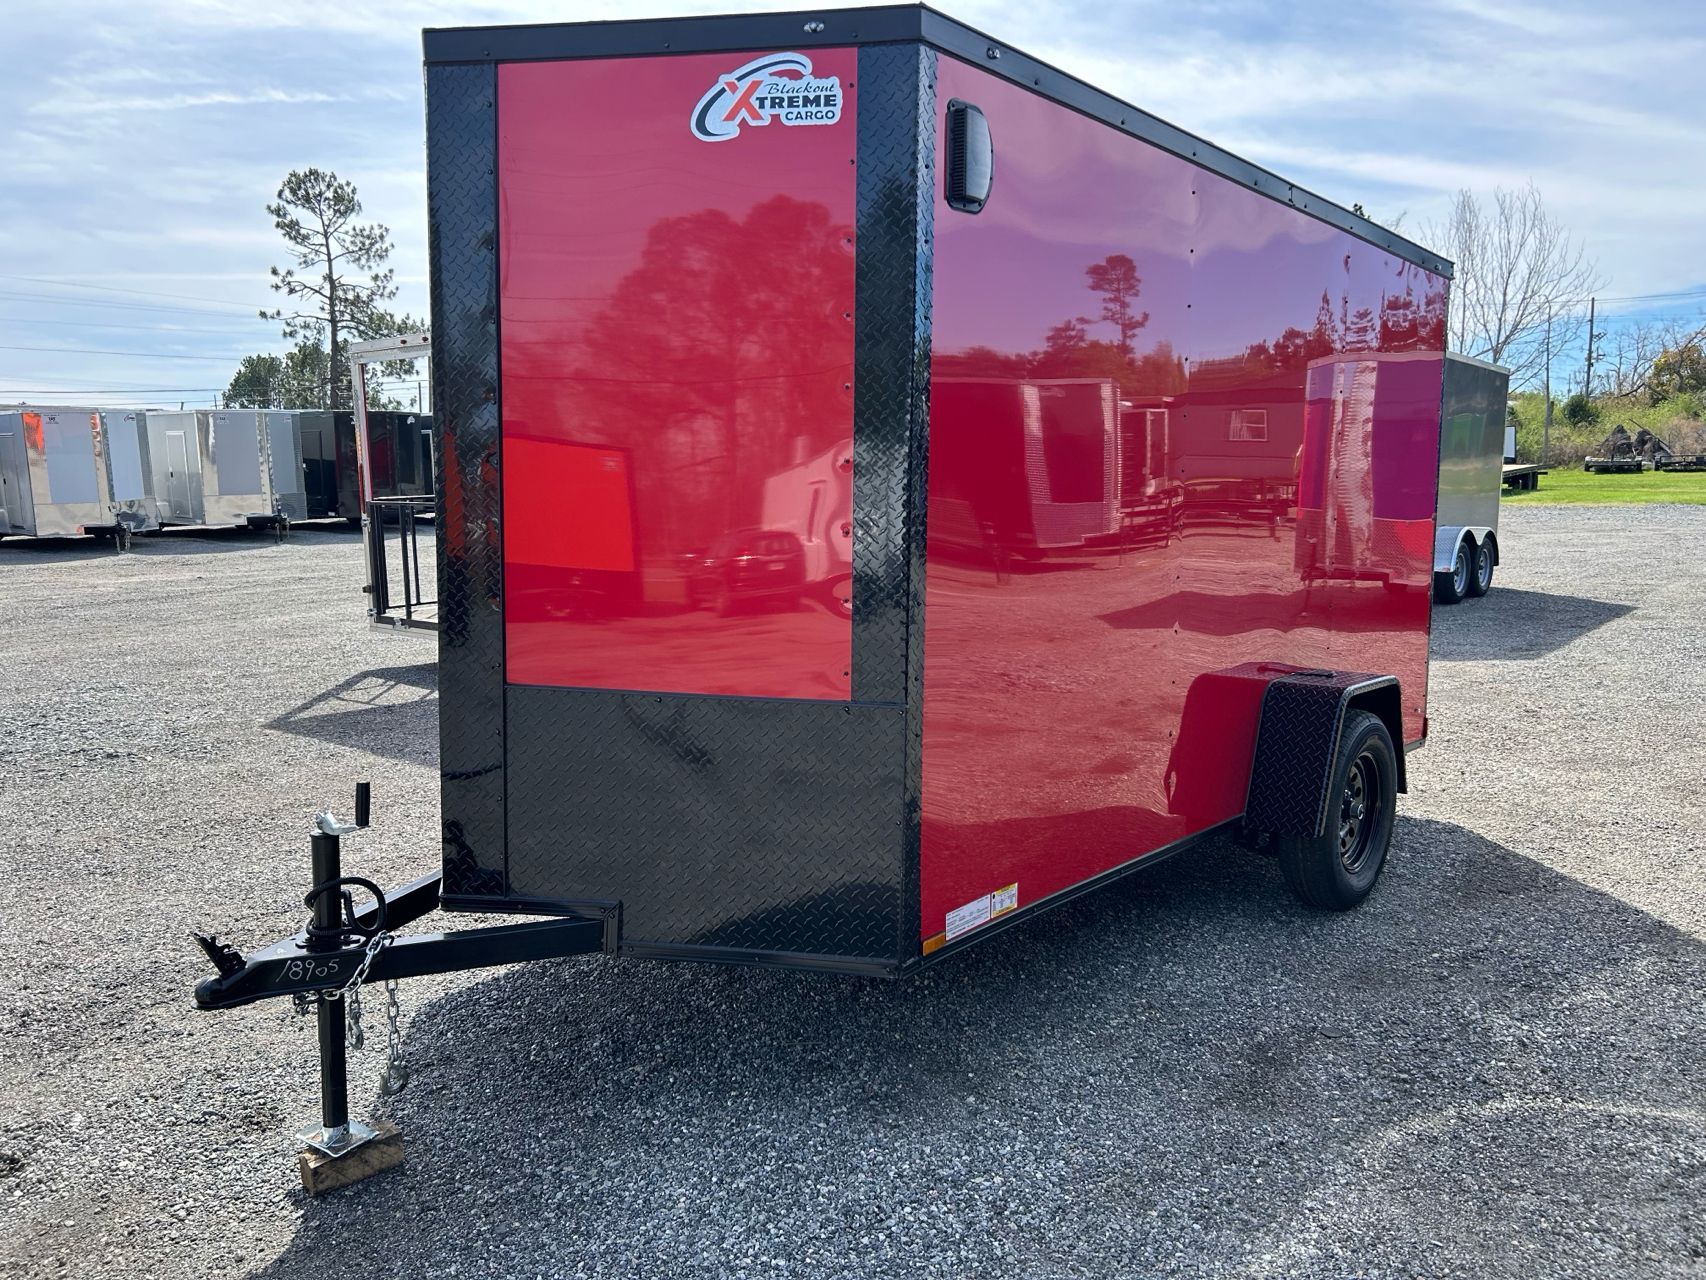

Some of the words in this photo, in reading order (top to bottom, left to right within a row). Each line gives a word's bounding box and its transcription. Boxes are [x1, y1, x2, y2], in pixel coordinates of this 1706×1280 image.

[764, 82, 835, 94] Blackout
[722, 80, 837, 121] XTREME
[785, 110, 836, 121] CARGO
[276, 958, 340, 982] 18905
